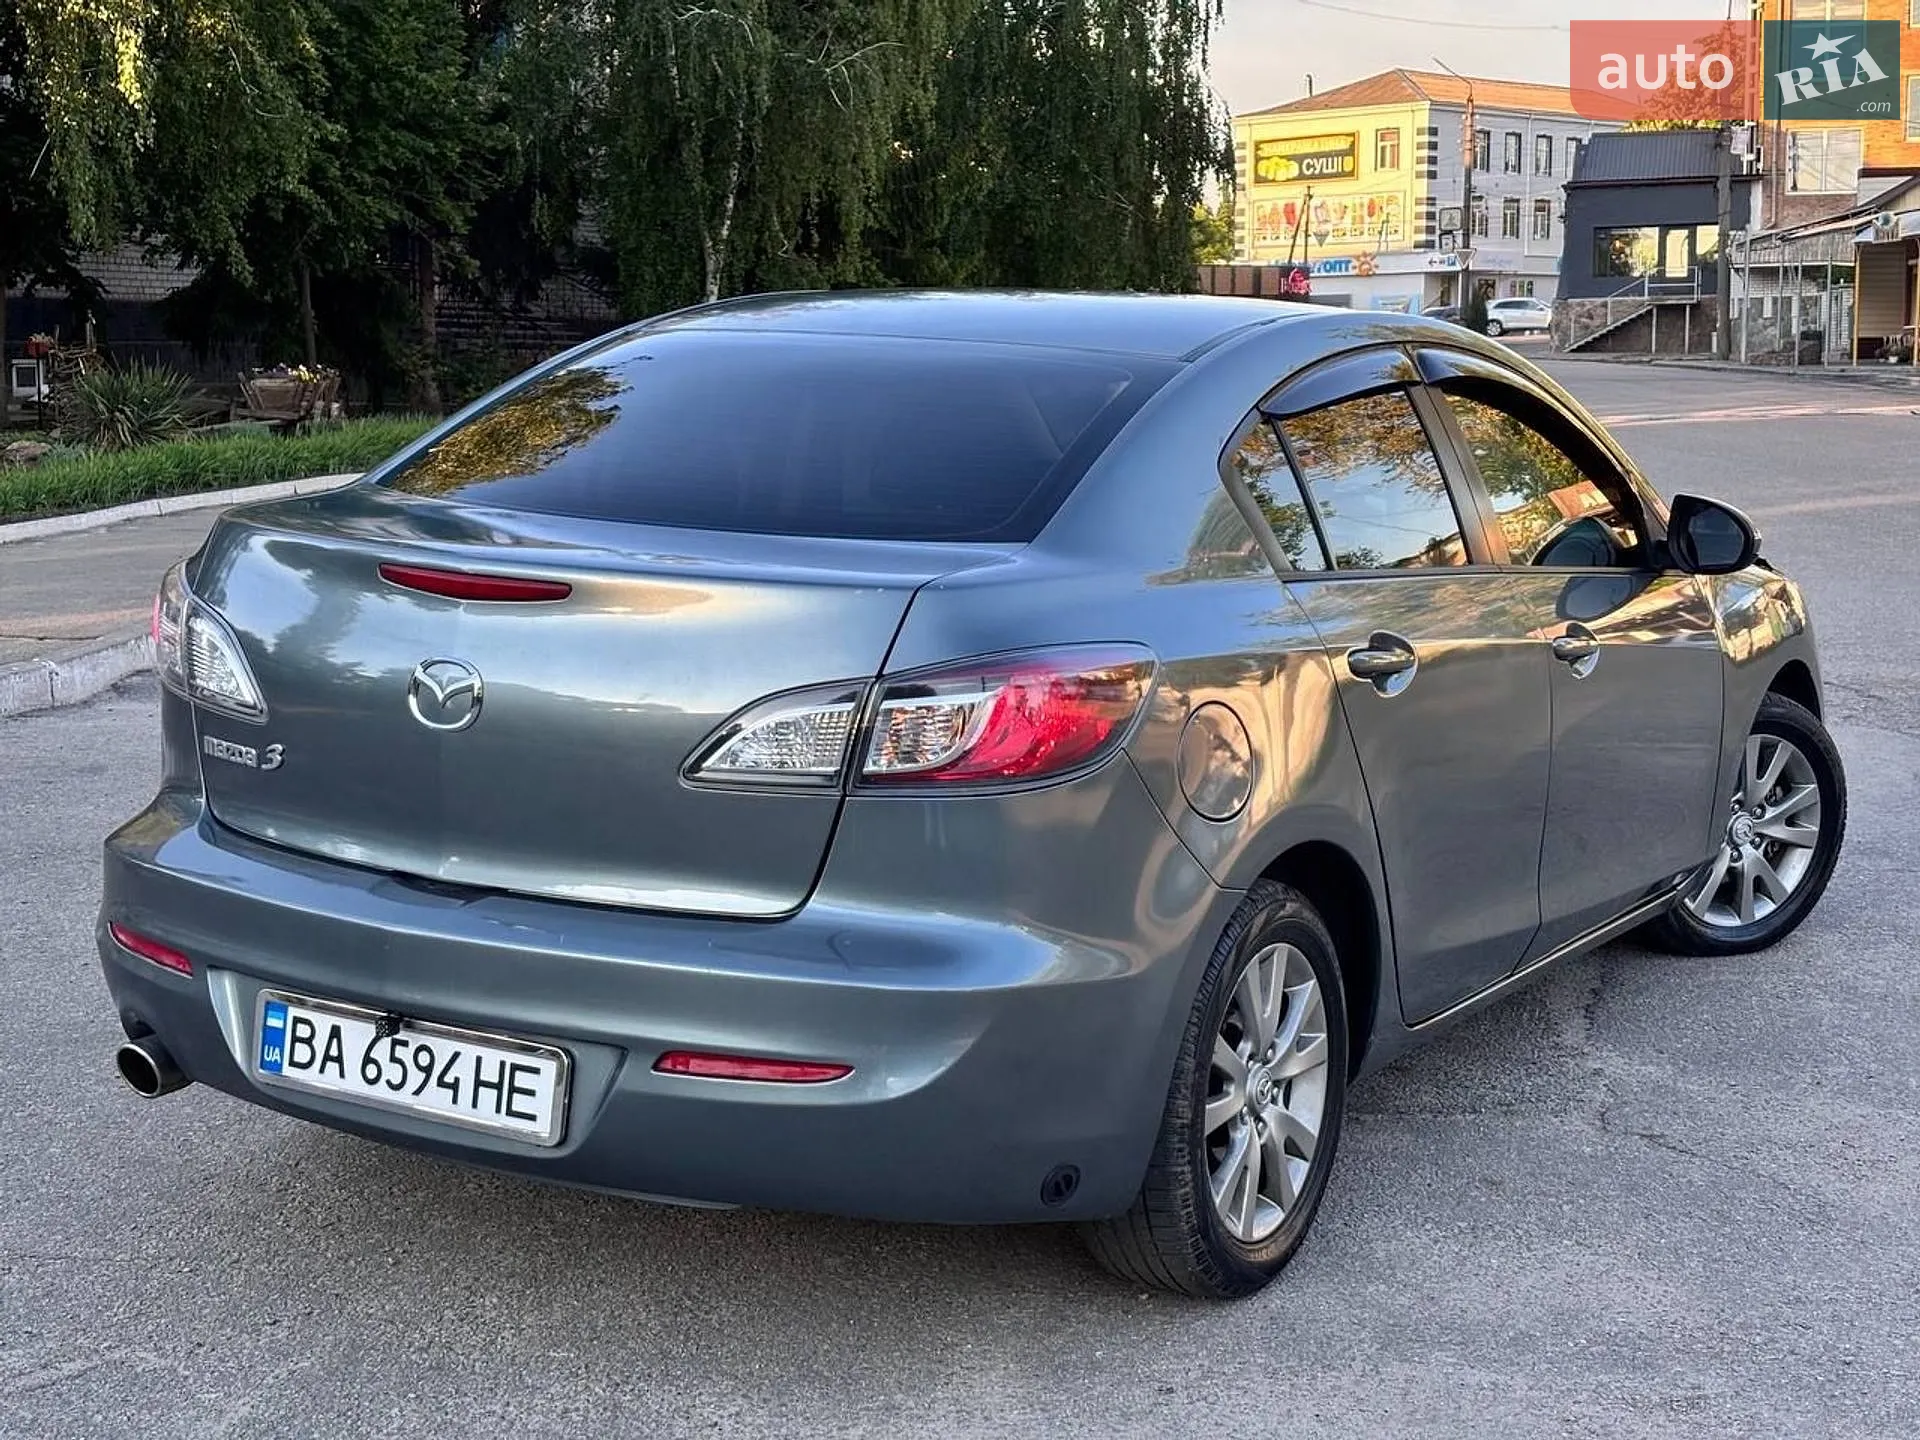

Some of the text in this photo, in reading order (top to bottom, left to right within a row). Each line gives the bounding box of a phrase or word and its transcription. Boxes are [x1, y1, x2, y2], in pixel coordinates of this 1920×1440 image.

[261, 743, 284, 770] 3
[263, 1046, 282, 1064] UA
[287, 1014, 345, 1079] BA
